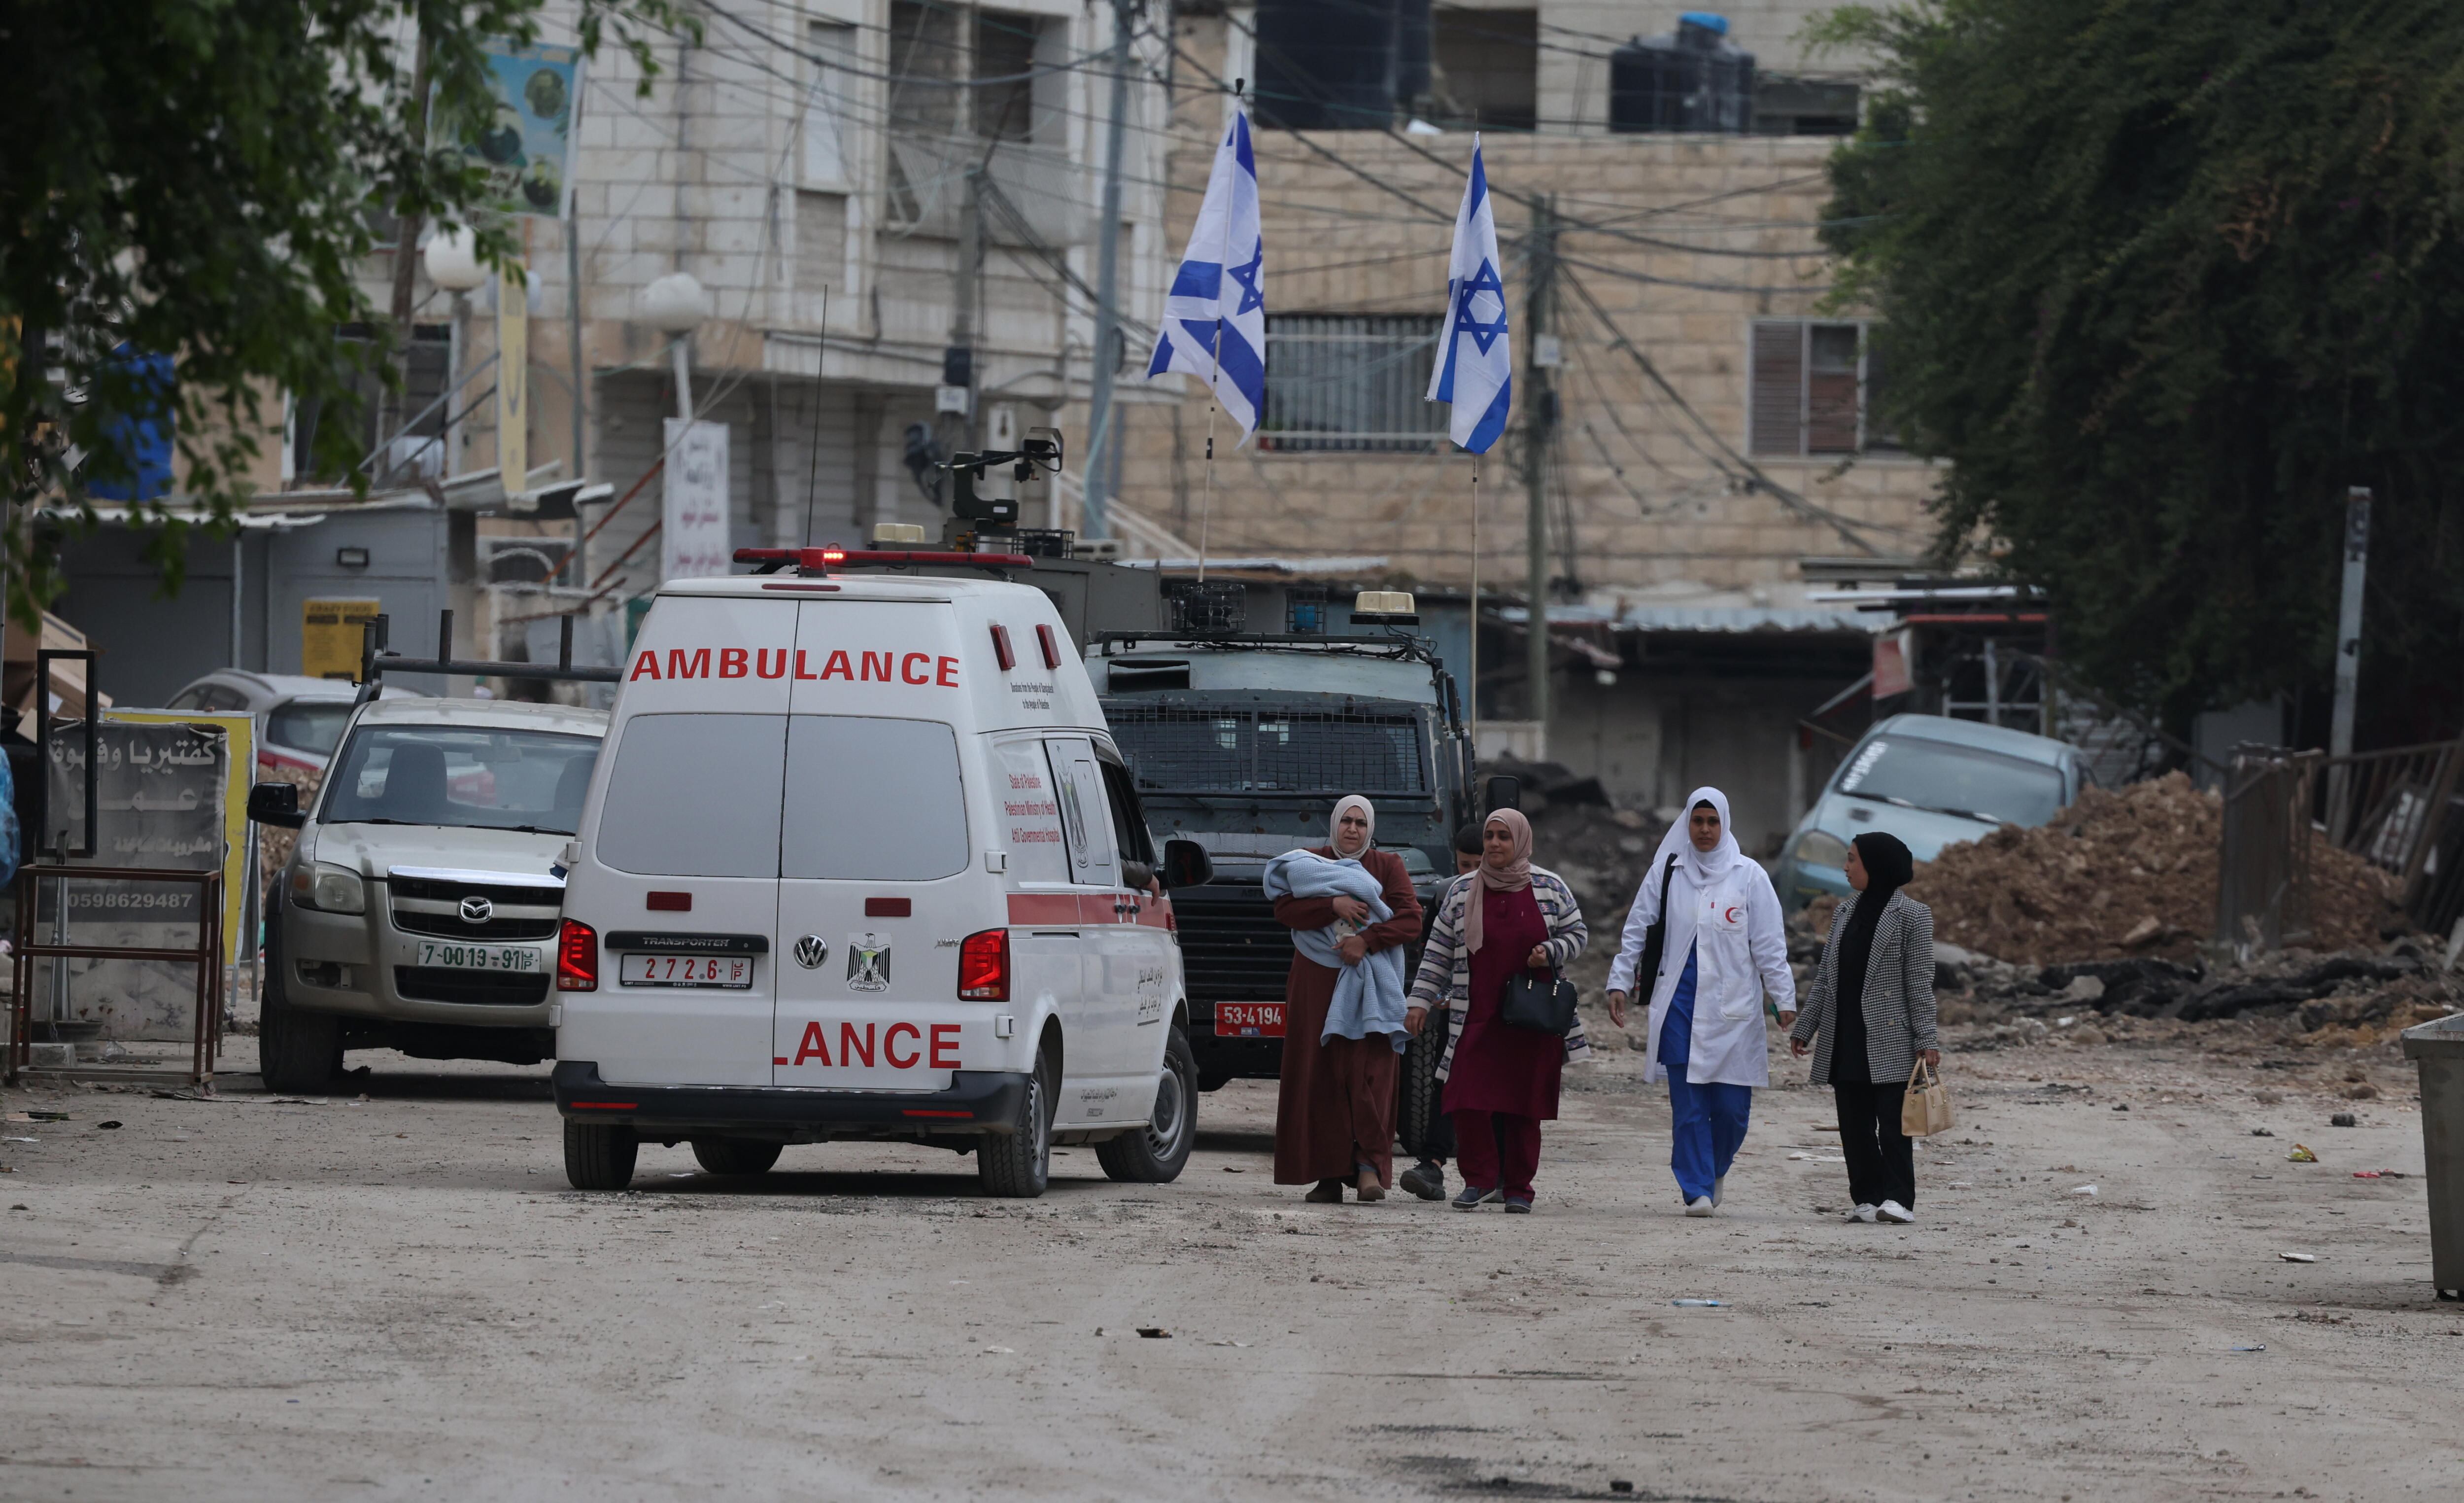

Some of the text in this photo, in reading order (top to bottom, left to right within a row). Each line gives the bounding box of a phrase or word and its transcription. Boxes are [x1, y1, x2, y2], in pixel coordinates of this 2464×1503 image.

[630, 648, 959, 688] AMBULANCE
[49, 737, 215, 774] كفتيريا وقوة
[1009, 773, 1042, 789] State of Palestine
[1004, 801, 1057, 819] Palestinian Ministry of Health
[1020, 828, 1046, 843] Governmental
[1044, 827, 1061, 846] Hospital
[68, 893, 193, 908] 0598629487
[643, 937, 730, 947] TRANSPORTER
[425, 945, 519, 969] 7-0013-91
[733, 971, 742, 980] P
[1224, 1007, 1281, 1025] 53-4194
[774, 1022, 961, 1069] ANCE
